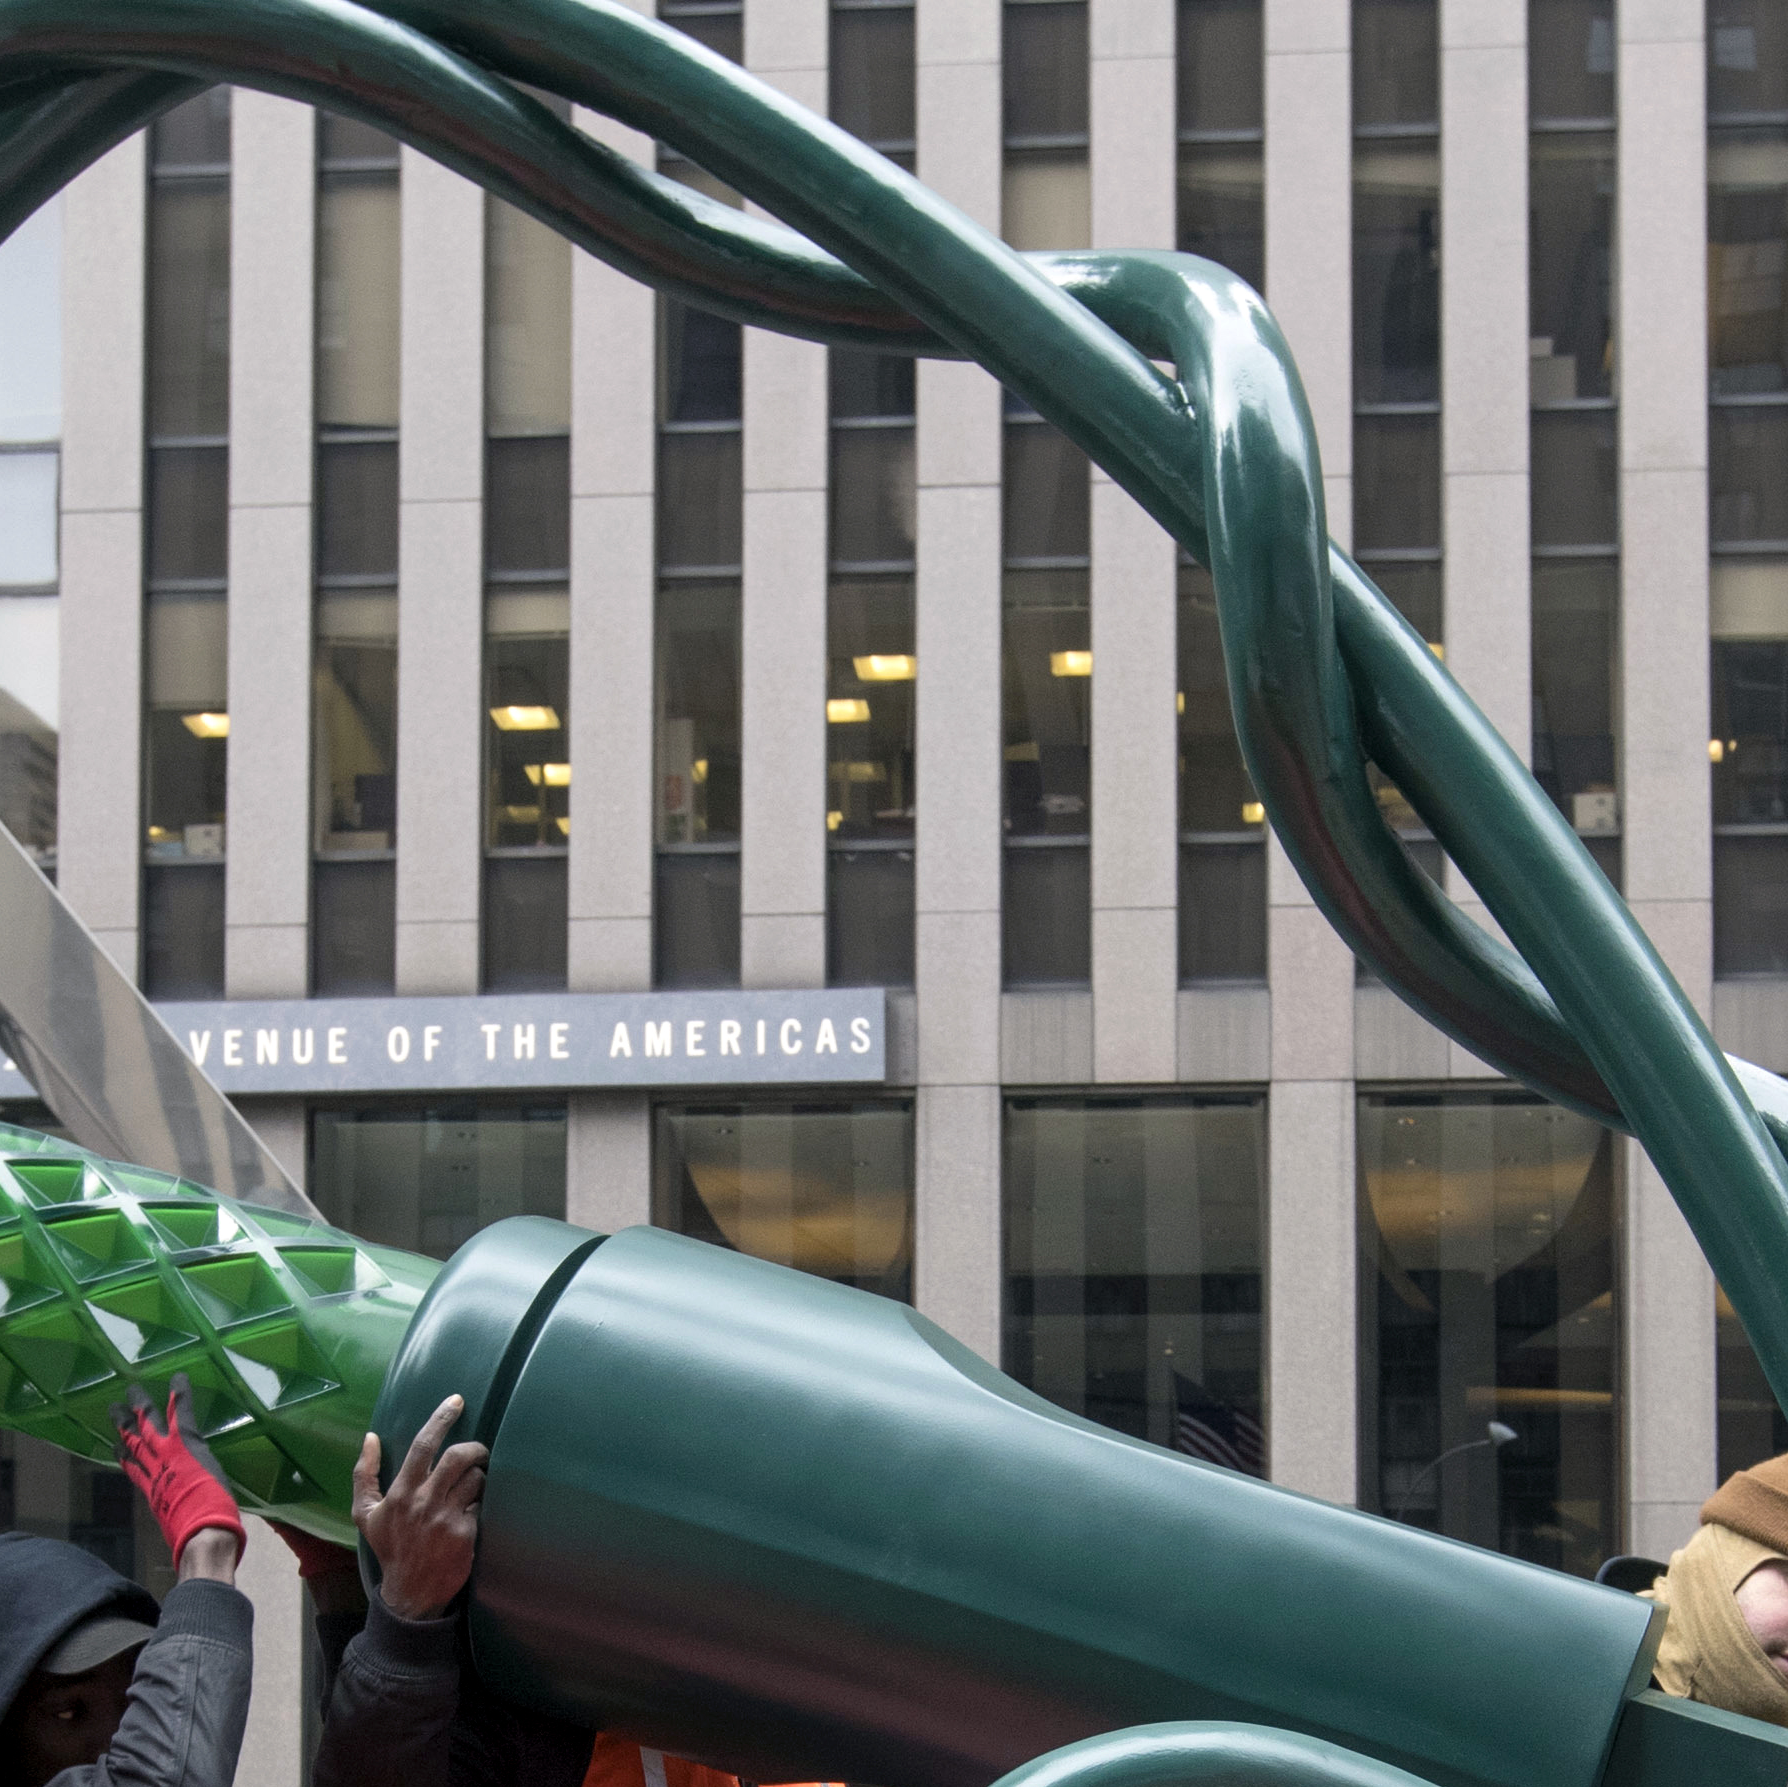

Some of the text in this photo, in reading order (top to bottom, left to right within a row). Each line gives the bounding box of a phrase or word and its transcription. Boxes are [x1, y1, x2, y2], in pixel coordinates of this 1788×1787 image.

[189, 1017, 872, 1066] VENUE OF THE AMERICAS
